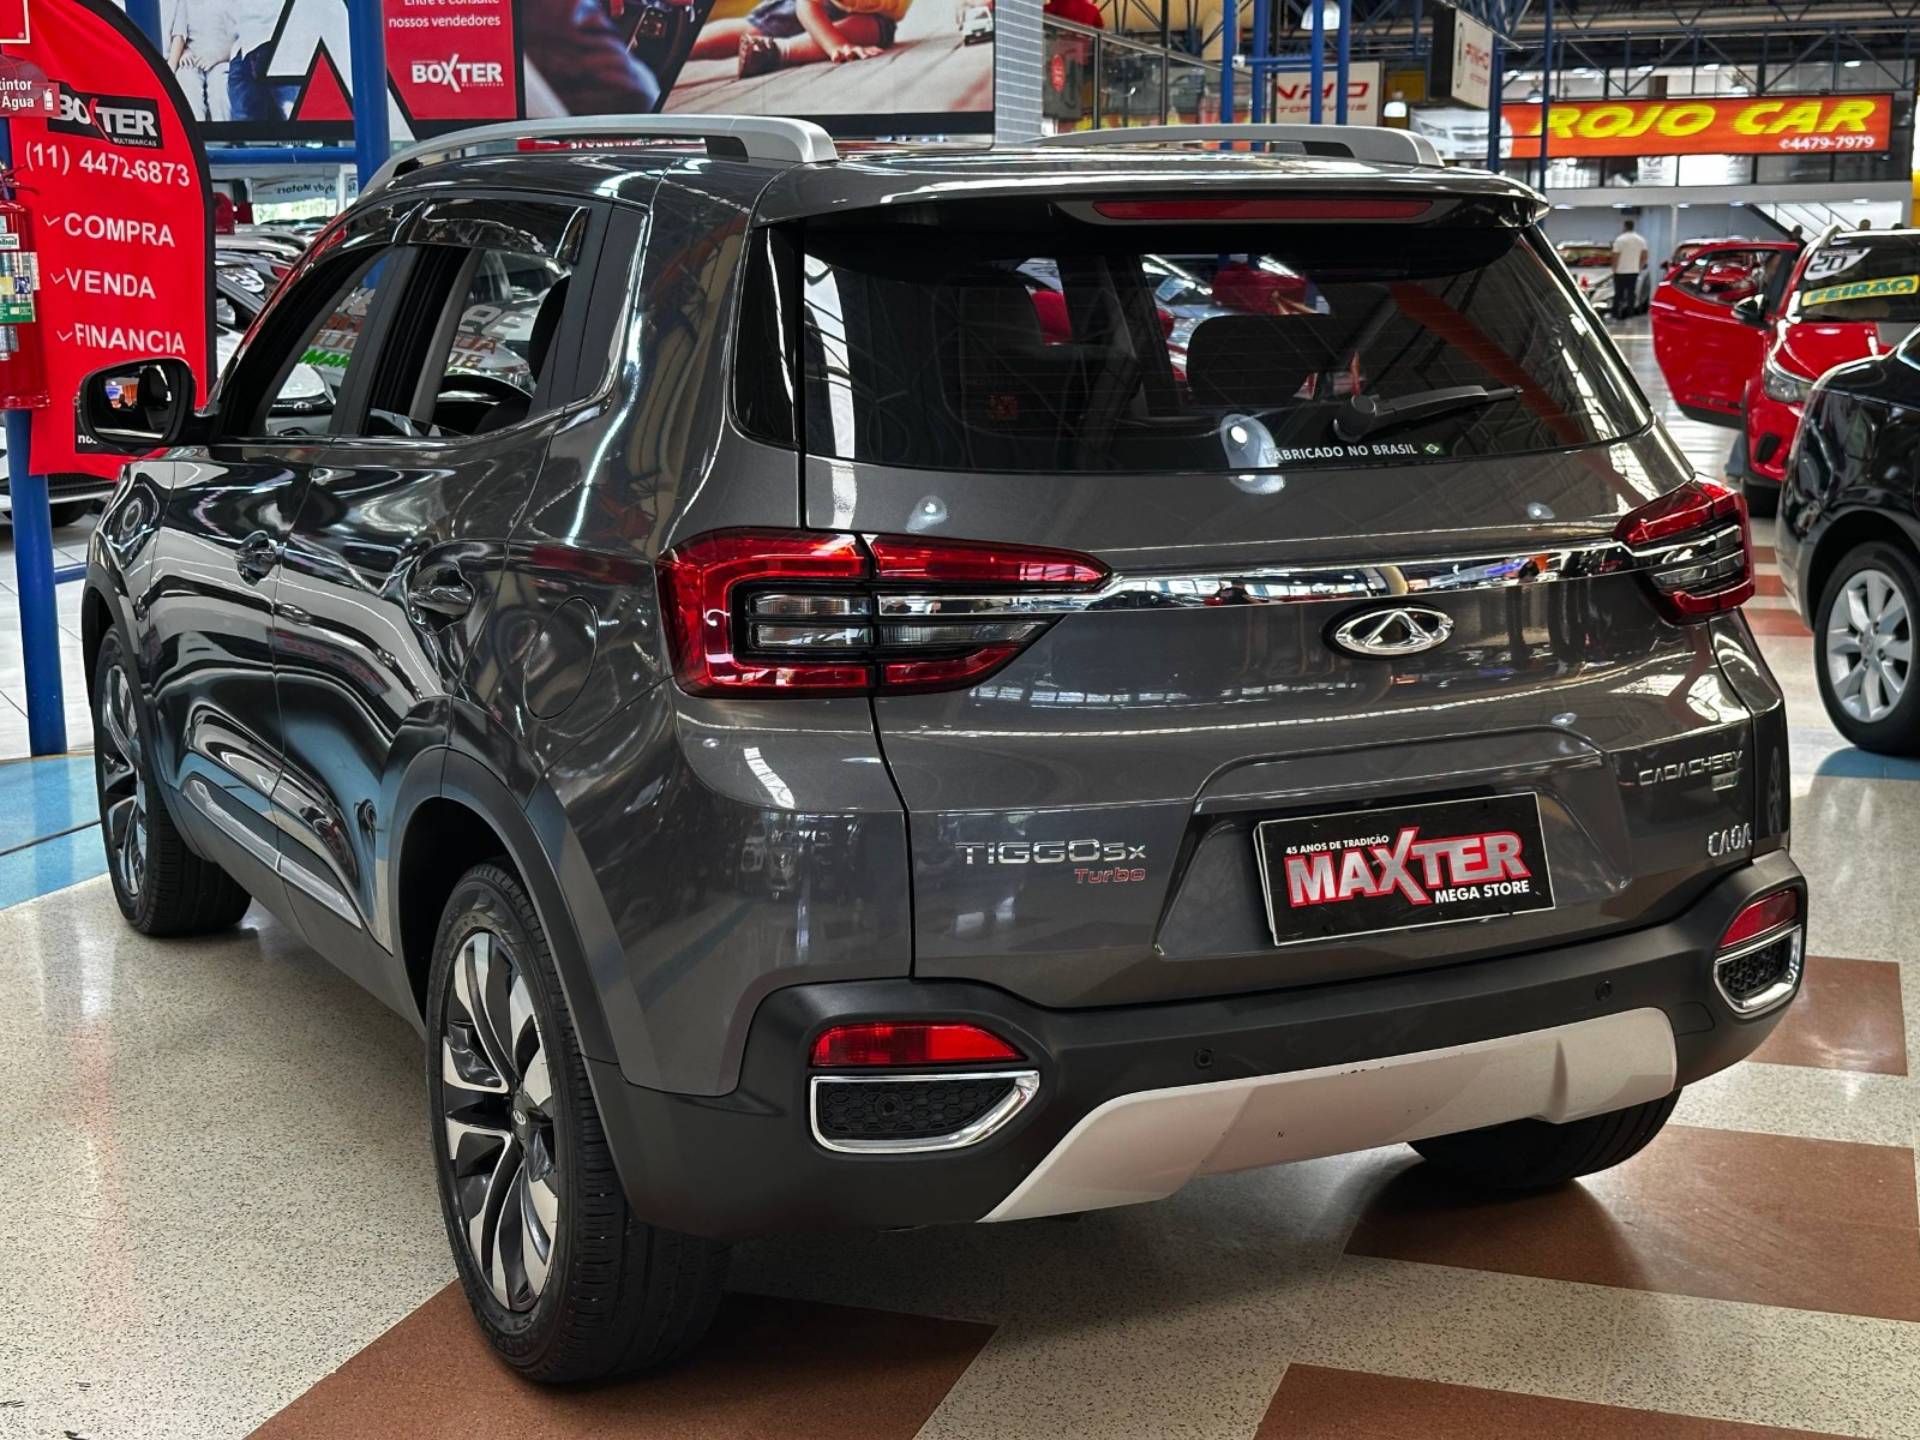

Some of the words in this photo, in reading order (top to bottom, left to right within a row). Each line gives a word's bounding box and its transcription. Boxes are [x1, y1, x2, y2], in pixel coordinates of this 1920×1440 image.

[388, 17, 429, 28] nossos
[431, 14, 501, 27] vendedores
[411, 53, 504, 93] BOXTER
[1, 91, 35, 111] Água
[57, 94, 158, 138] BOXTER
[1530, 104, 1717, 139] ROJO
[1733, 99, 1876, 135] CAR
[1789, 135, 1876, 150] 4479-7979
[25, 141, 70, 176] (11)
[79, 149, 190, 187] 4472-6873
[64, 212, 176, 248] COMPRA
[1809, 254, 1849, 272] 20
[65, 267, 157, 299] VENDA
[74, 322, 186, 355] FINANCIA
[1266, 446, 1344, 464] FABRICADO
[1347, 445, 1369, 458] NO
[1372, 443, 1418, 456] BRASIL
[1285, 845, 1298, 855] 45
[1299, 841, 1327, 854] ANOS
[1329, 840, 1342, 850] DE
[1342, 833, 1389, 849] TRADIÇÃO
[1074, 866, 1146, 884] Turbo
[1284, 825, 1531, 908] MAXTER
[1434, 887, 1481, 905] MEGA
[1483, 880, 1530, 898] STORE
